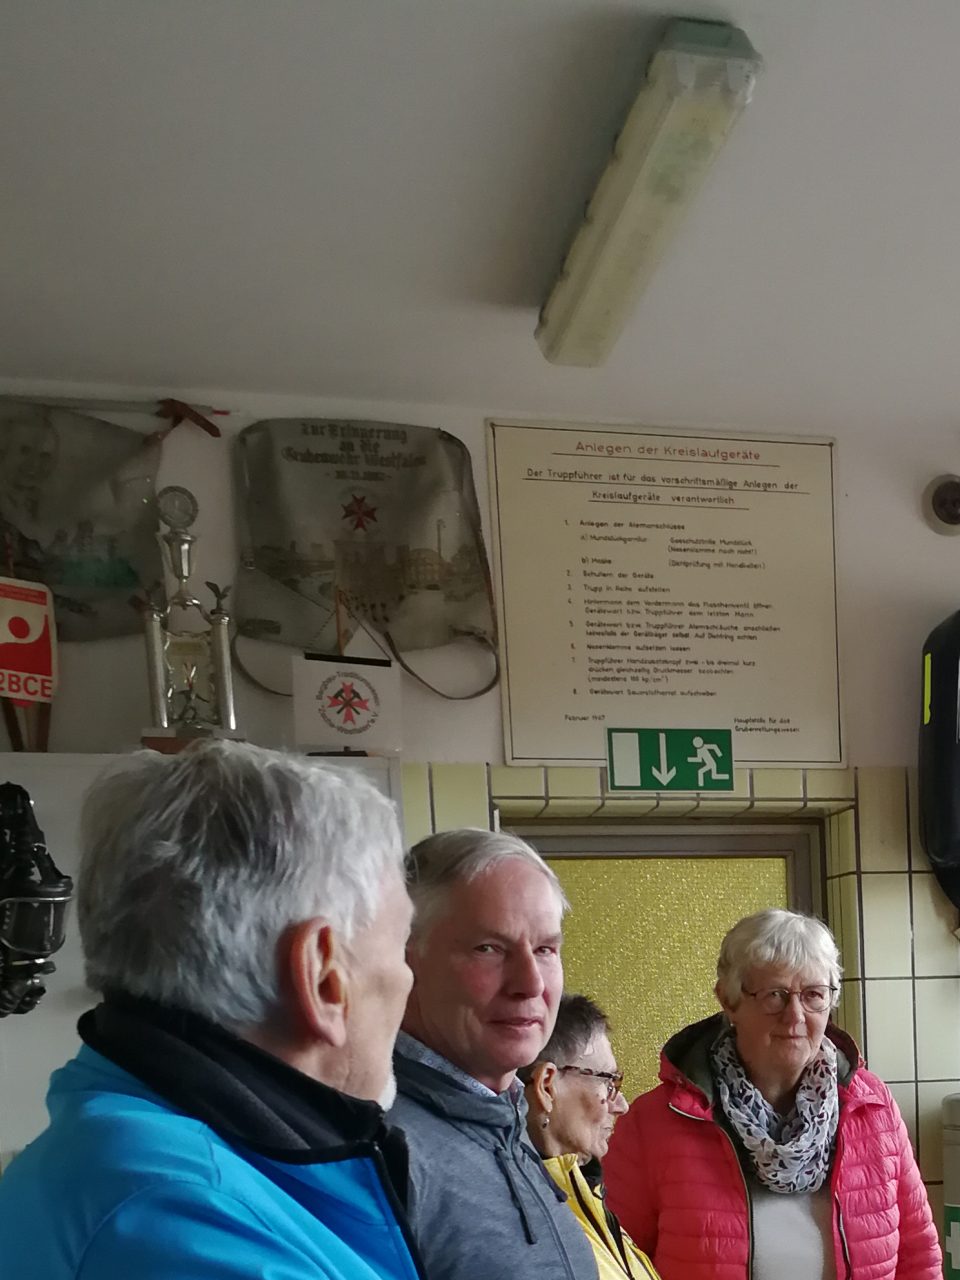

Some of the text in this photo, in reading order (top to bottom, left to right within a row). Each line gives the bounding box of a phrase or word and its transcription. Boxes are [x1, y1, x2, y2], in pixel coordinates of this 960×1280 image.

[575, 441, 761, 462] Anlegen der Kreislaufgeräte
[527, 468, 543, 478] Der
[547, 469, 603, 482] Truppführer
[608, 472, 620, 481] ist
[623, 472, 636, 482] für
[640, 473, 657, 483] das
[742, 479, 778, 492] Anlegen
[784, 481, 799, 490] der
[591, 490, 735, 505] Kreislaufgeräte verantwortlich
